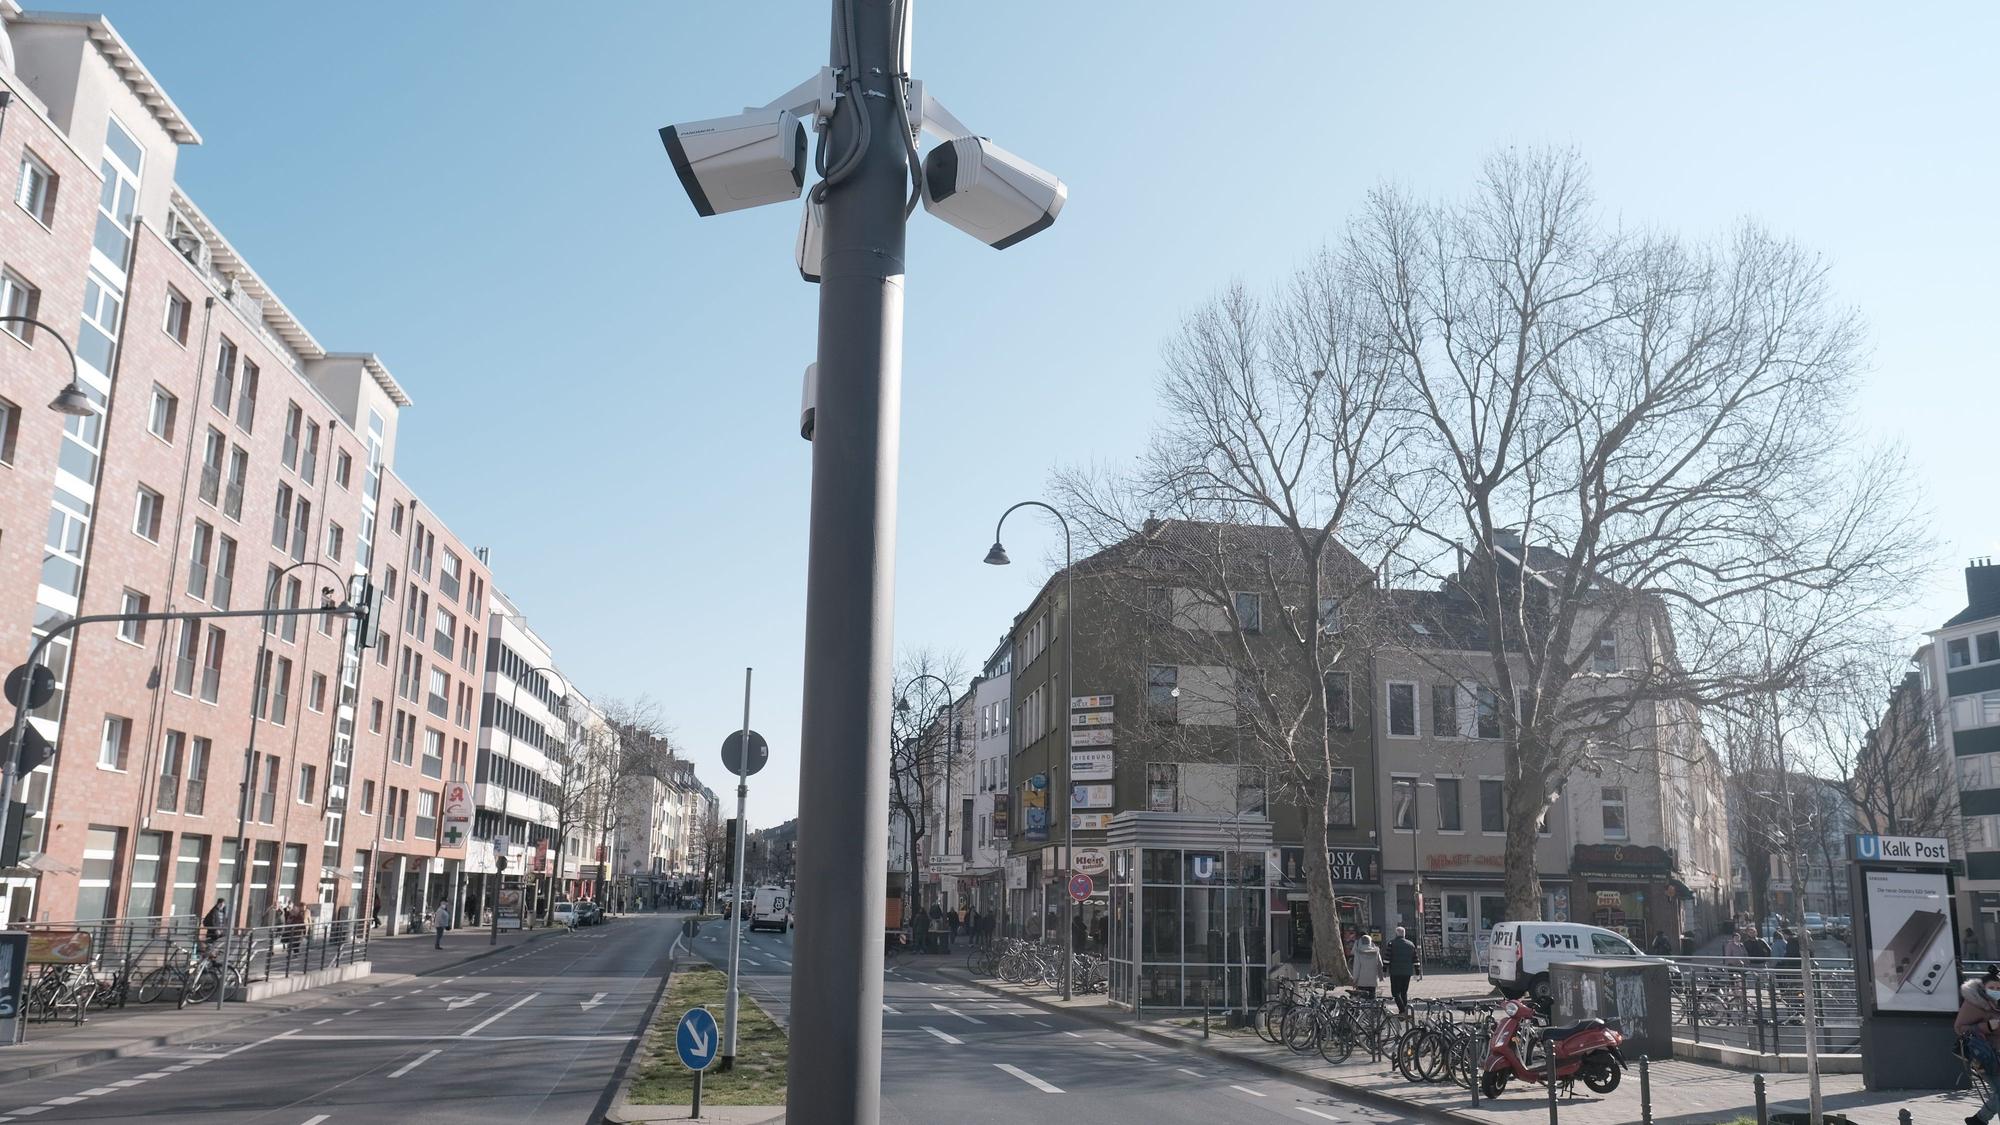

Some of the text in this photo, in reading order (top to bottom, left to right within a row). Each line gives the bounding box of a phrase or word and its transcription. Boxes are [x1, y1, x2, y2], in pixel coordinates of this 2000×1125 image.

[1860, 837, 1946, 858] U Kalk Post
[1195, 857, 1213, 878] U
[1328, 852, 1355, 866] OSK
[1493, 930, 1513, 946] OPTI
[1535, 932, 1579, 949] OPTI
